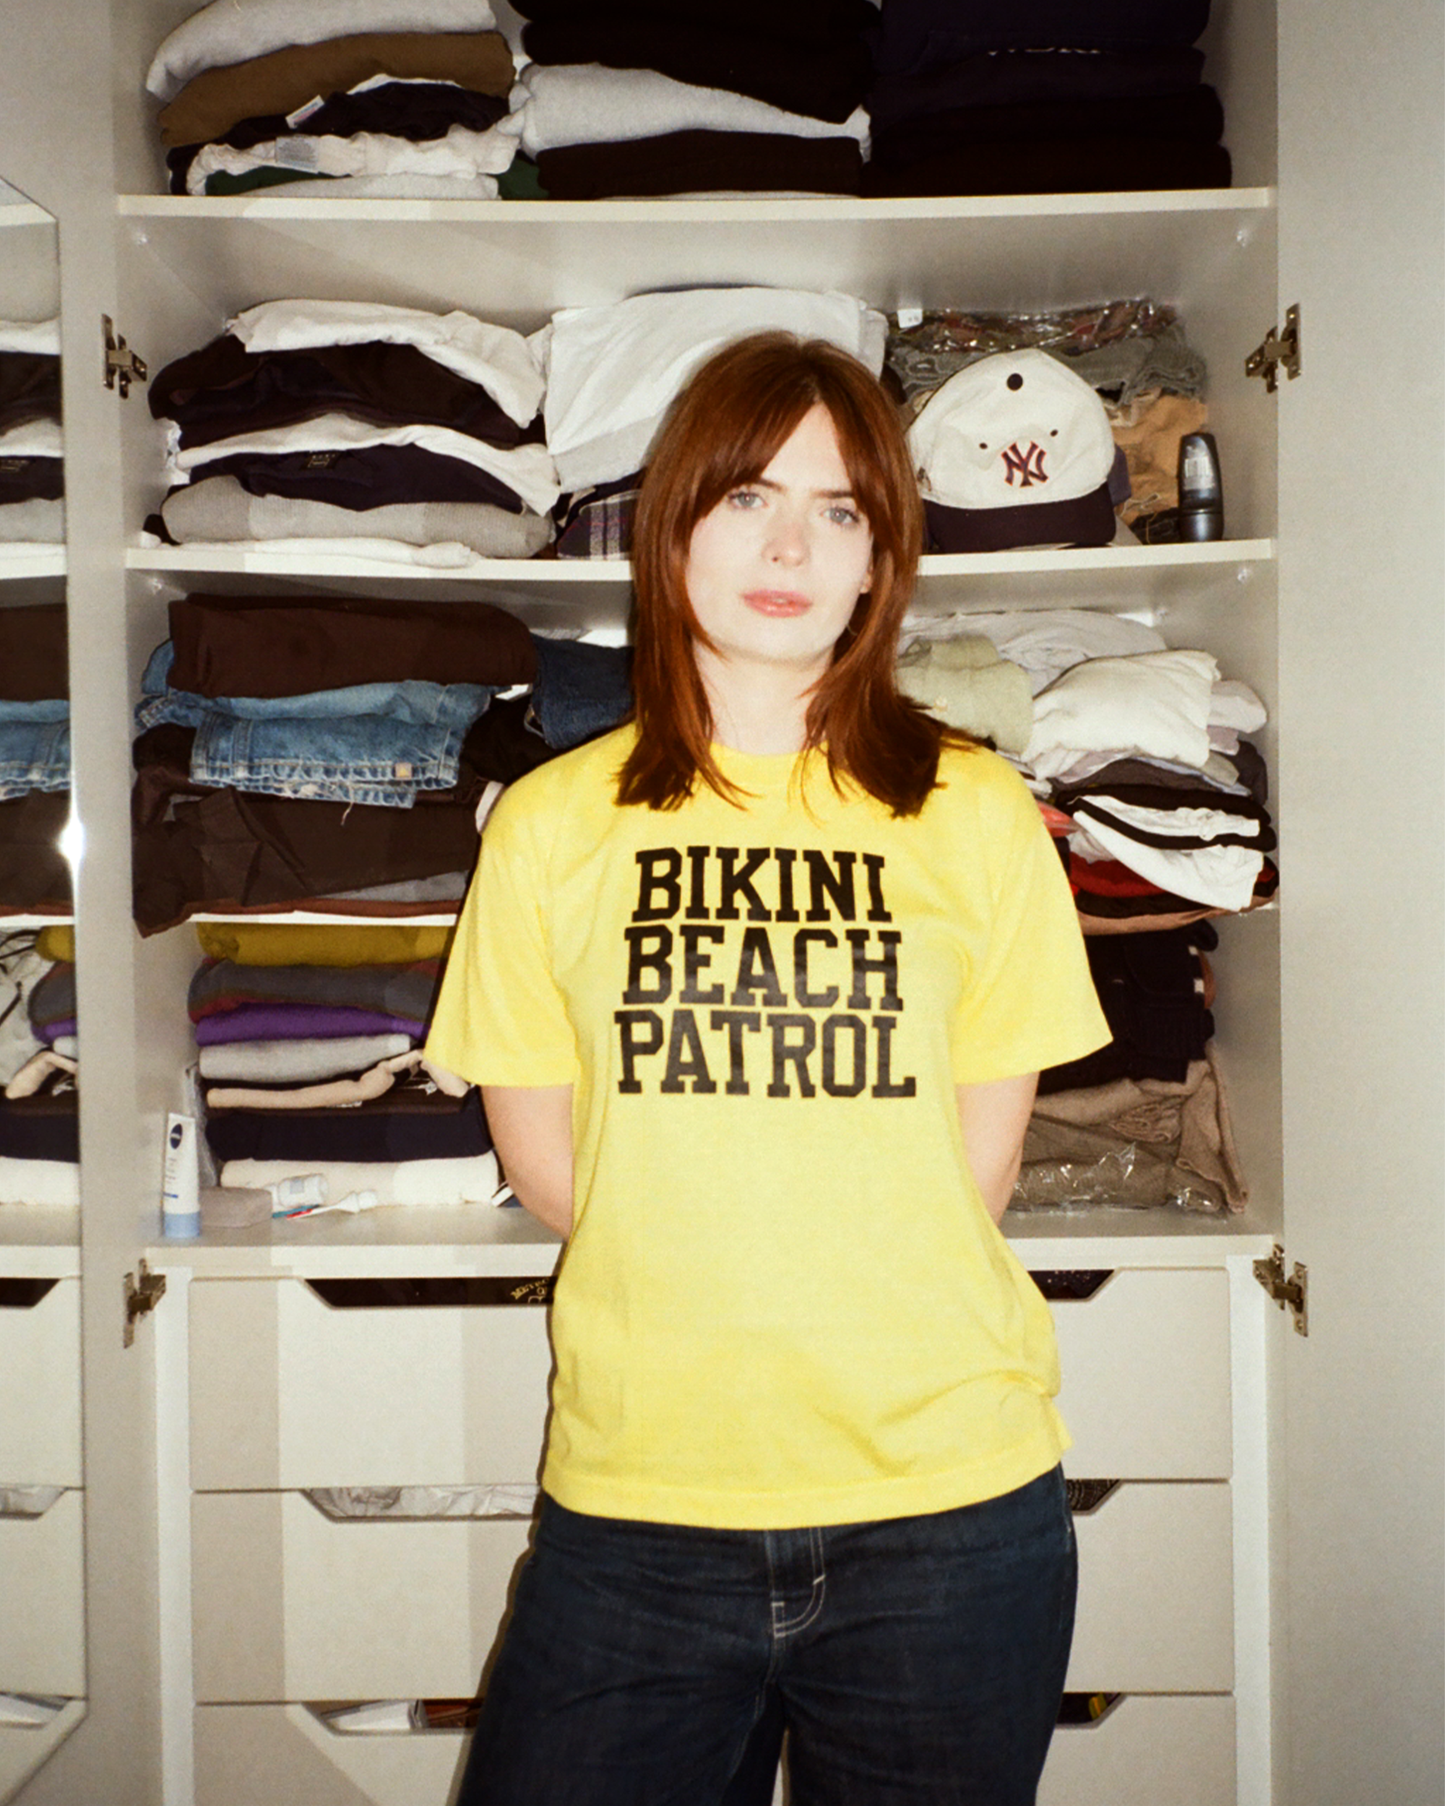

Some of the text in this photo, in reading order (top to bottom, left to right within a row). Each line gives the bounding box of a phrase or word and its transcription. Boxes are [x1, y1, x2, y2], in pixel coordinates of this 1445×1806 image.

[1001, 440, 1049, 488] NY
[631, 845, 893, 923] BIKINI
[622, 923, 904, 1012] BEACH
[613, 1008, 917, 1099] PATROL
